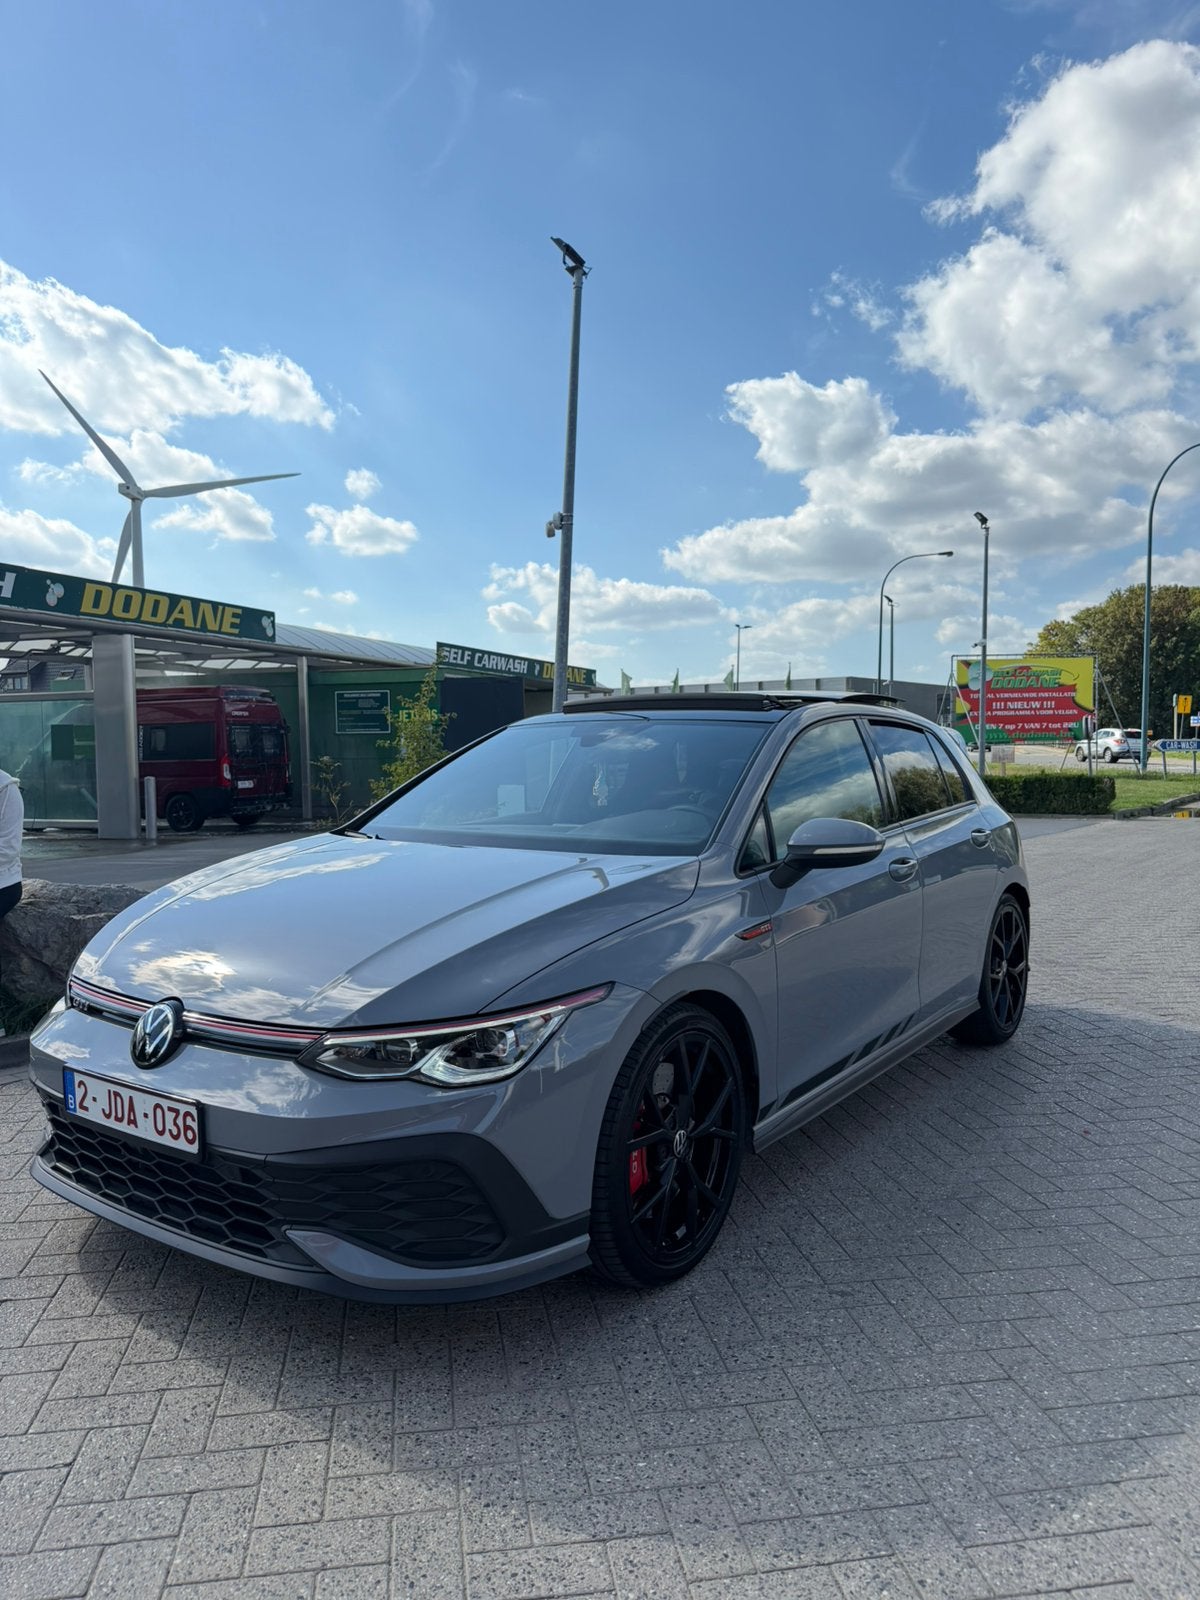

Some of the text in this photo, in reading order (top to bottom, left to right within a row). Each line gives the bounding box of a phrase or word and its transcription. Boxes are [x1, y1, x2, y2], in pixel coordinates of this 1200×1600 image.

[80, 582, 242, 634] DODANE
[442, 647, 587, 684] SELF CARWASH DANE
[991, 677, 1060, 688] DODANE
[1006, 701, 1041, 709] NIEUW
[1166, 741, 1197, 749] CAR-WASH
[68, 1094, 75, 1109] B
[77, 1079, 197, 1146] 2-JDA-036
